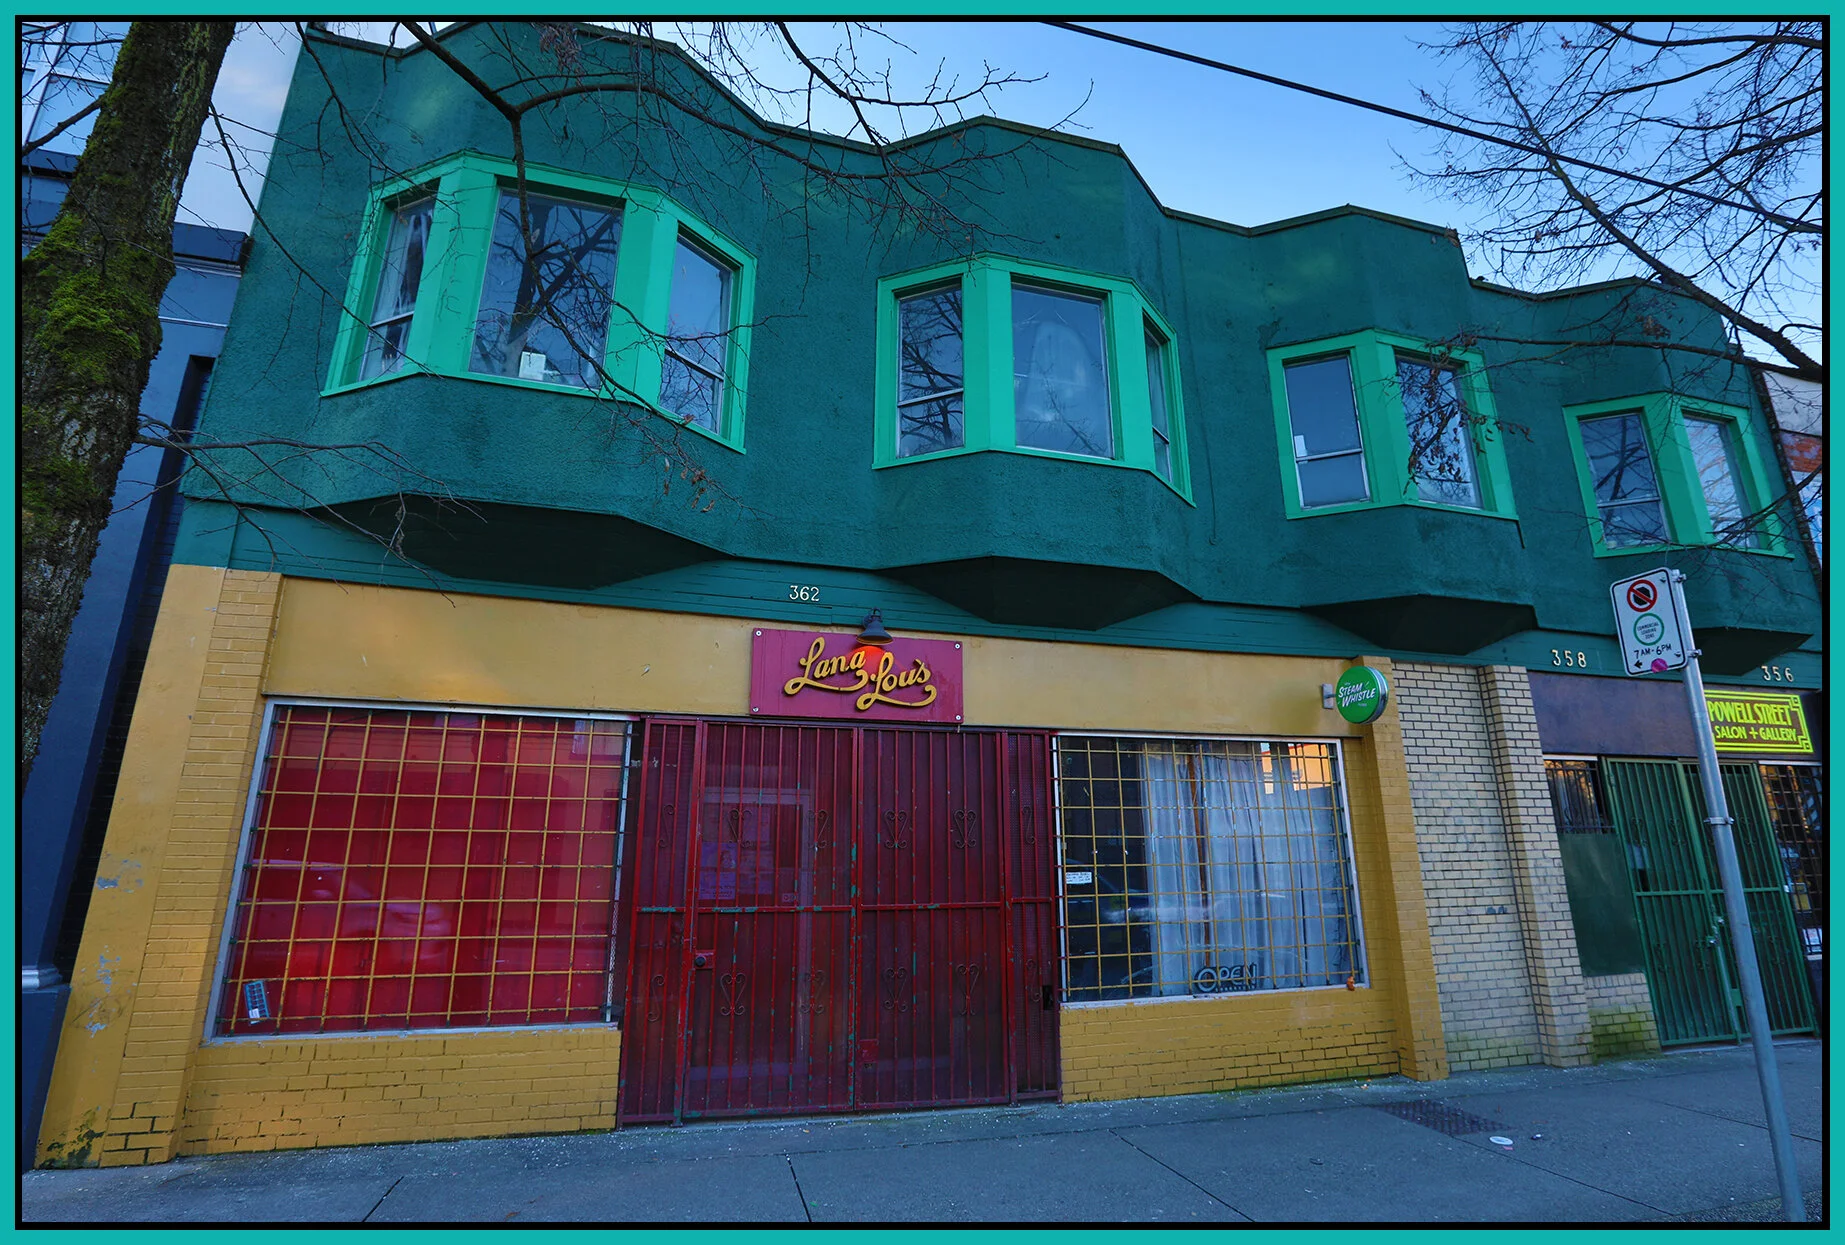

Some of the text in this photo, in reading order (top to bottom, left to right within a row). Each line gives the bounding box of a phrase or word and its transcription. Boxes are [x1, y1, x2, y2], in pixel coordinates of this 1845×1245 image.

[789, 585, 820, 602] 362
[784, 636, 869, 695] Lana
[1551, 649, 1587, 668] 358
[1761, 665, 1795, 682] 356
[1338, 682, 1363, 698] STEAM
[1342, 687, 1376, 708] WHISTLE
[1706, 701, 1793, 726] POWELL STREET
[1714, 725, 1748, 739] SALON
[1759, 727, 1798, 742] GALLERY
[1197, 964, 1257, 993] OPEN
